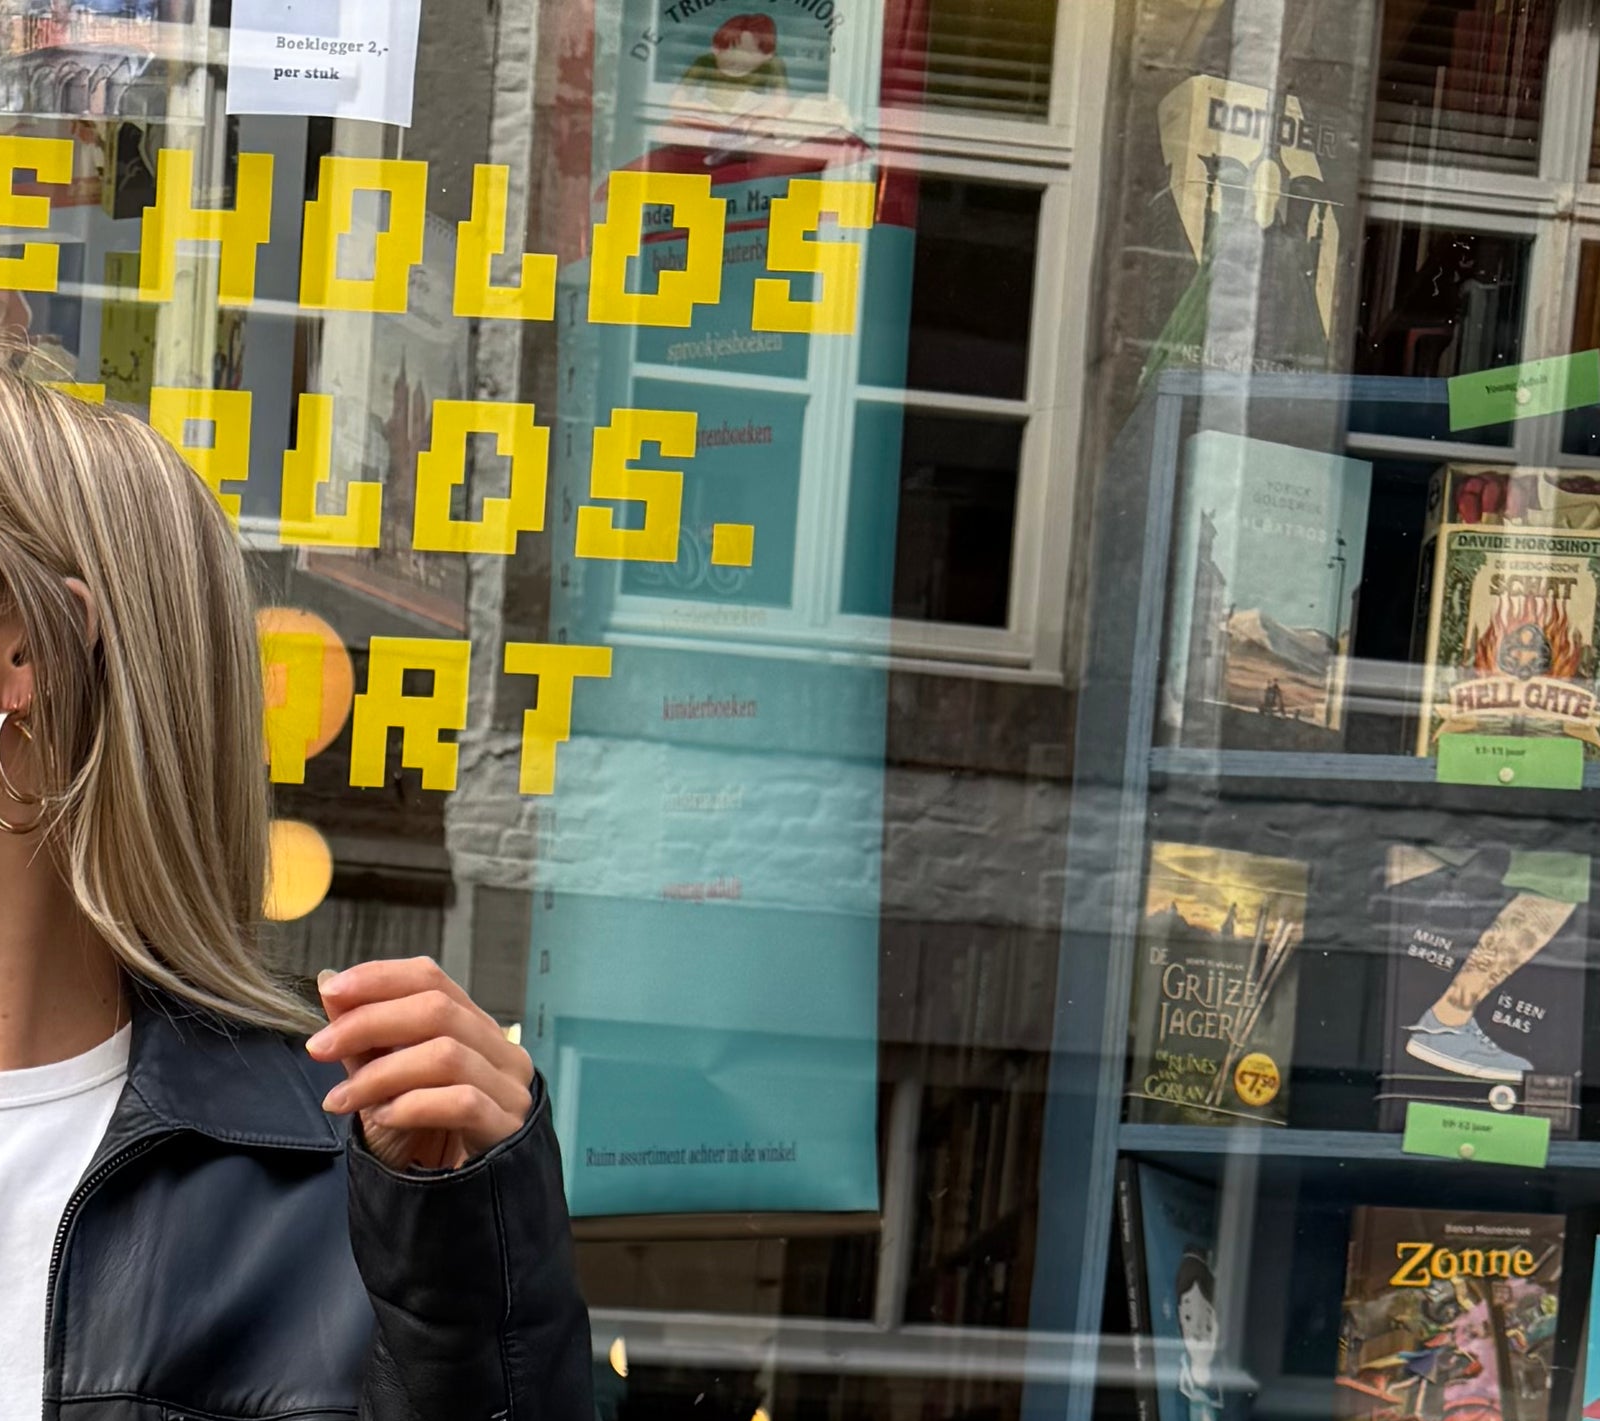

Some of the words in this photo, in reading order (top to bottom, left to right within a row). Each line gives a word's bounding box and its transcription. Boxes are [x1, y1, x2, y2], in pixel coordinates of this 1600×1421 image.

[276, 36, 364, 56] Boeklegger
[367, 41, 390, 56] 2,-
[274, 67, 299, 80] per
[305, 67, 340, 80] stuk
[138, 149, 876, 333] HOLDS
[1458, 535, 1511, 550] DAVIDE
[1454, 681, 1521, 714] HELL
[1523, 684, 1594, 719] GATE
[1407, 944, 1455, 969] BROER
[1497, 994, 1512, 1010] IS
[1515, 1000, 1546, 1021] EEN
[1492, 1010, 1532, 1034] BAAS
[586, 1147, 616, 1167] Ruim
[618, 1145, 687, 1167] assortiment
[688, 1143, 725, 1164] achter
[727, 1143, 739, 1163] in
[740, 1140, 755, 1162] de
[757, 1140, 797, 1163] winkel
[1389, 1242, 1536, 1287] Zonne
